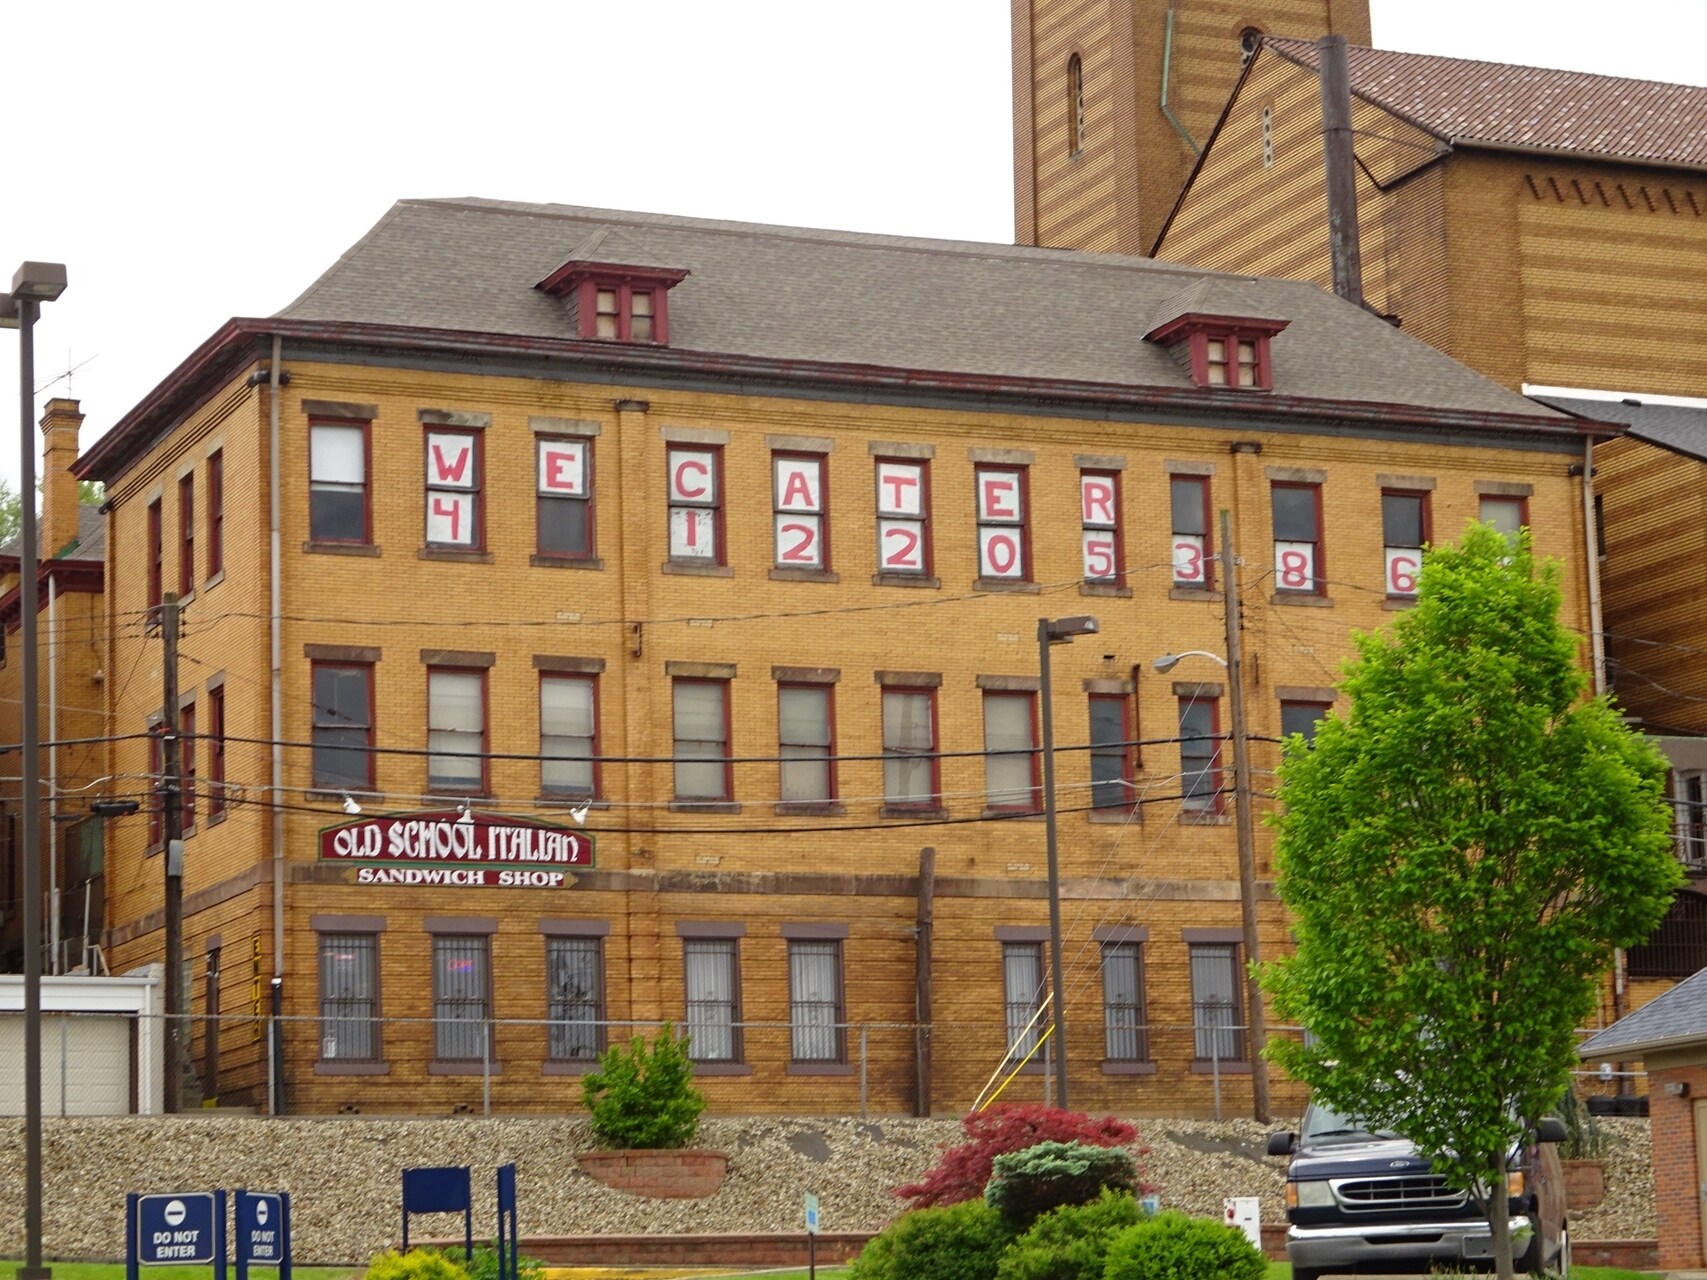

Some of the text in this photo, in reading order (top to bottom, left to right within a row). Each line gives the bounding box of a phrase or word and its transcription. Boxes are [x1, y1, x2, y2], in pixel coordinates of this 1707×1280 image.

[333, 819, 579, 863] OLD SCHOOL ITALIAN
[358, 867, 564, 887] SANDWICH SHOP
[153, 1230, 199, 1244] DO NOT
[251, 1230, 275, 1242] DO NOT
[156, 1245, 196, 1259] ENTER
[252, 1245, 274, 1257] ENTER
